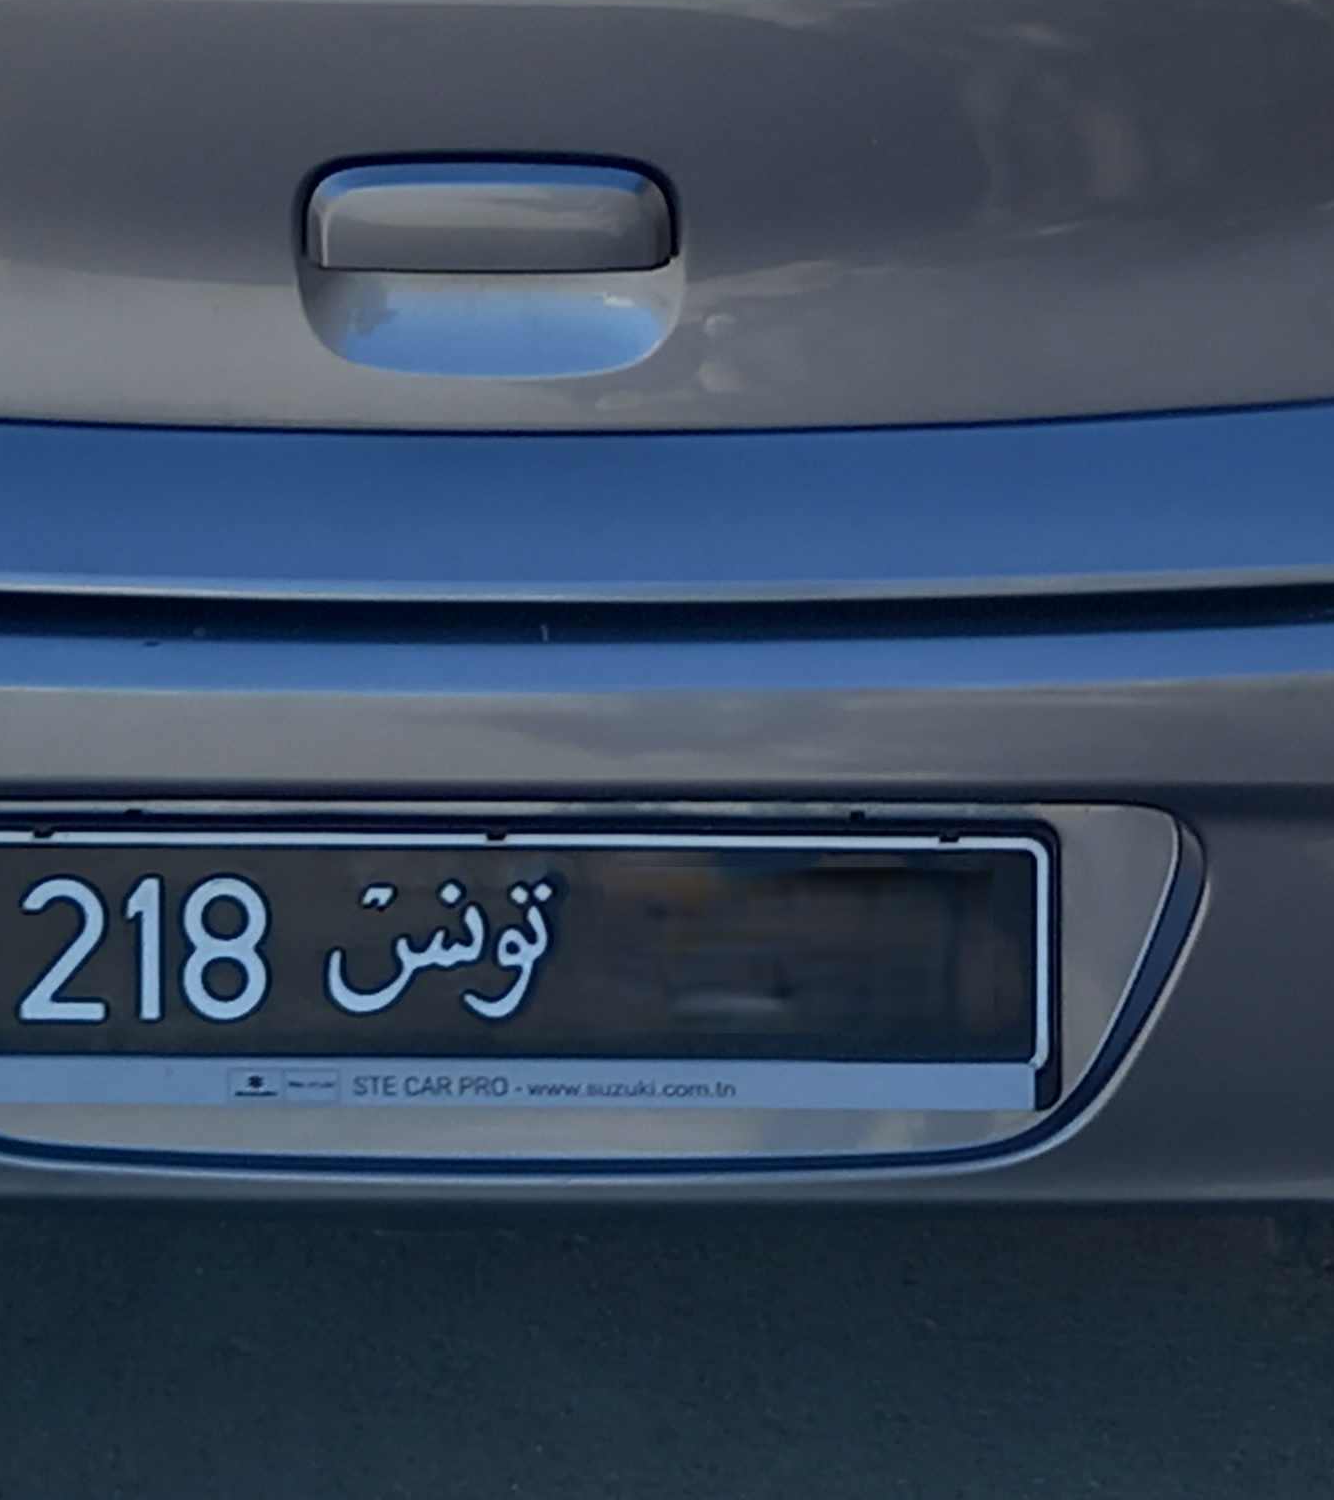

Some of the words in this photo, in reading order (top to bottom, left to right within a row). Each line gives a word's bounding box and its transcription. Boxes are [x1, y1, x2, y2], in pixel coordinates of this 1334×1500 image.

[18, 876, 269, 1023] 218
[326, 881, 553, 1021] تونس
[352, 1075, 397, 1097] STE
[404, 1075, 452, 1097] CAR
[459, 1076, 509, 1098] PRO
[527, 1078, 737, 1099] www.suzuki.com.tn
